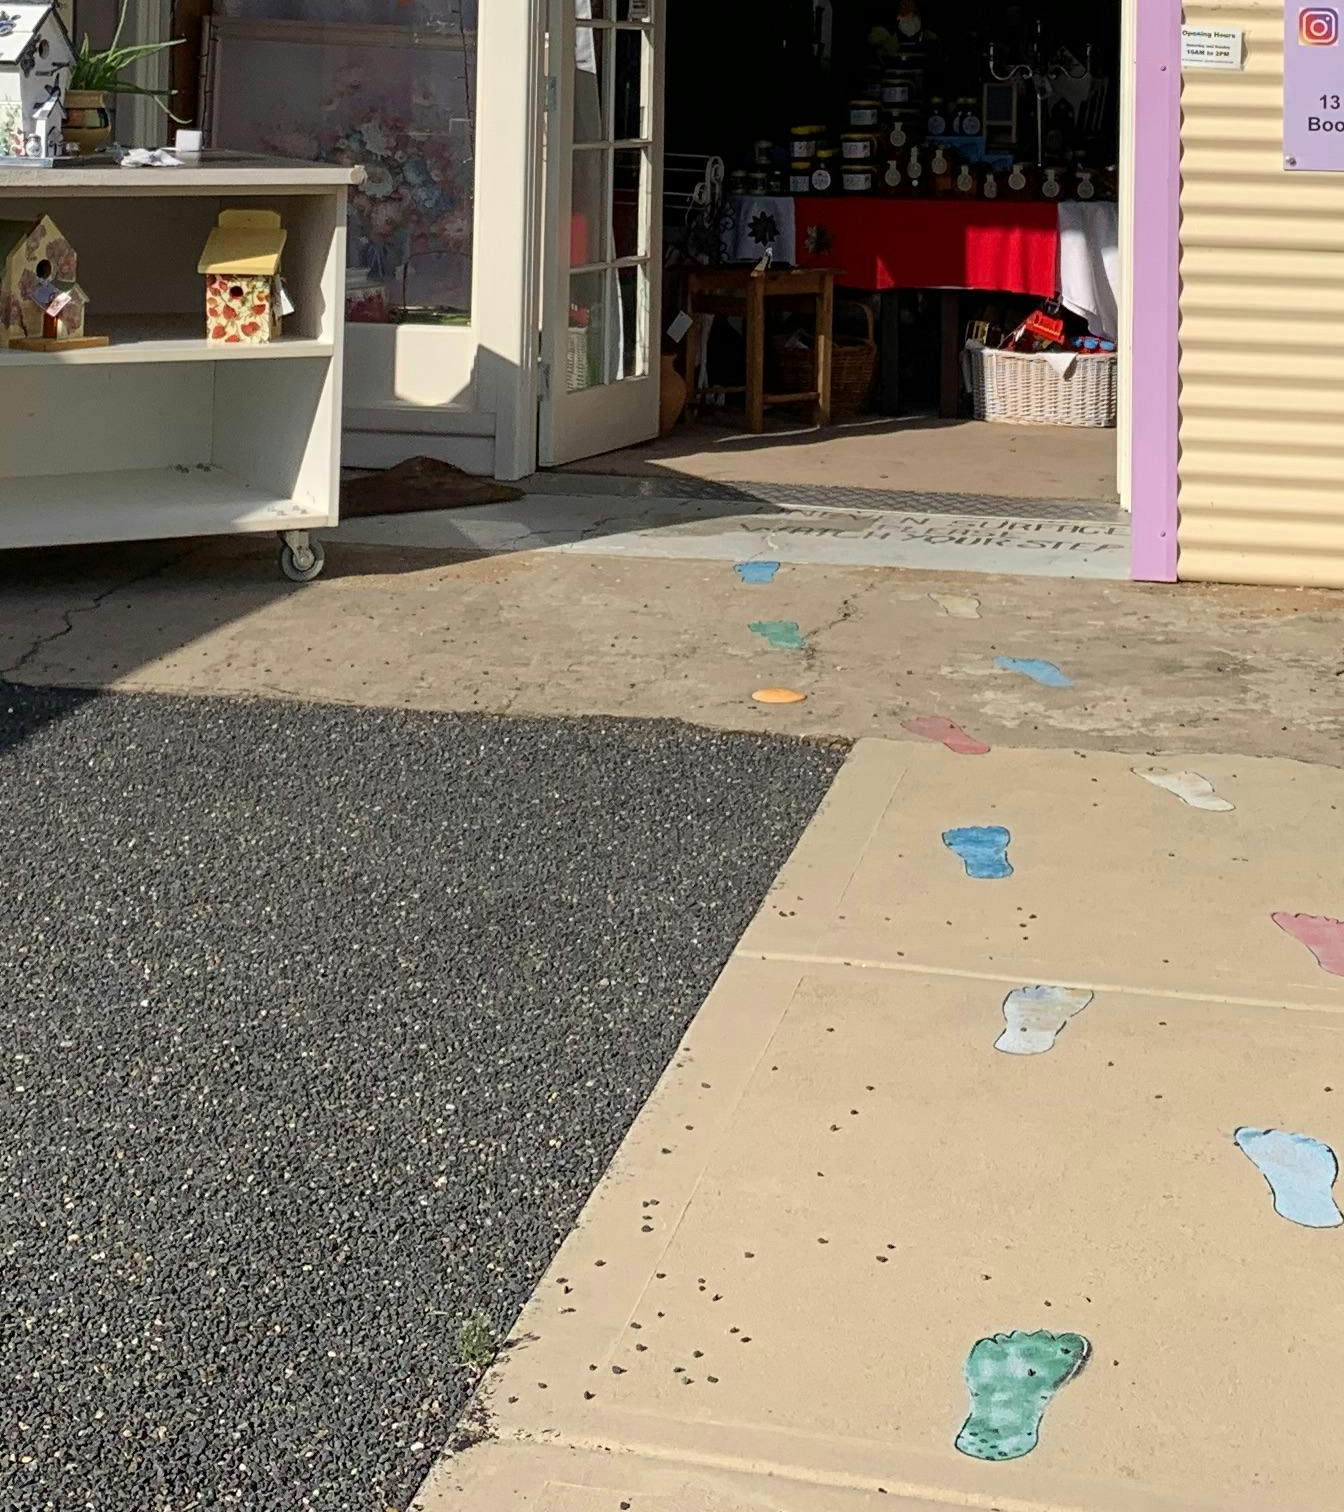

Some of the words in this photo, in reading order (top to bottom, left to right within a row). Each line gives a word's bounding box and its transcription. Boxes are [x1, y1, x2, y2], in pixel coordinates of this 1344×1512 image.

[1181, 29, 1212, 38] Opening
[1214, 31, 1236, 39] Hours
[1319, 95, 1341, 110] 13
[947, 520, 1131, 536] SURFACE
[740, 522, 891, 540] WATCH
[901, 533, 1012, 546] YOUR
[1017, 539, 1125, 552] STEP
